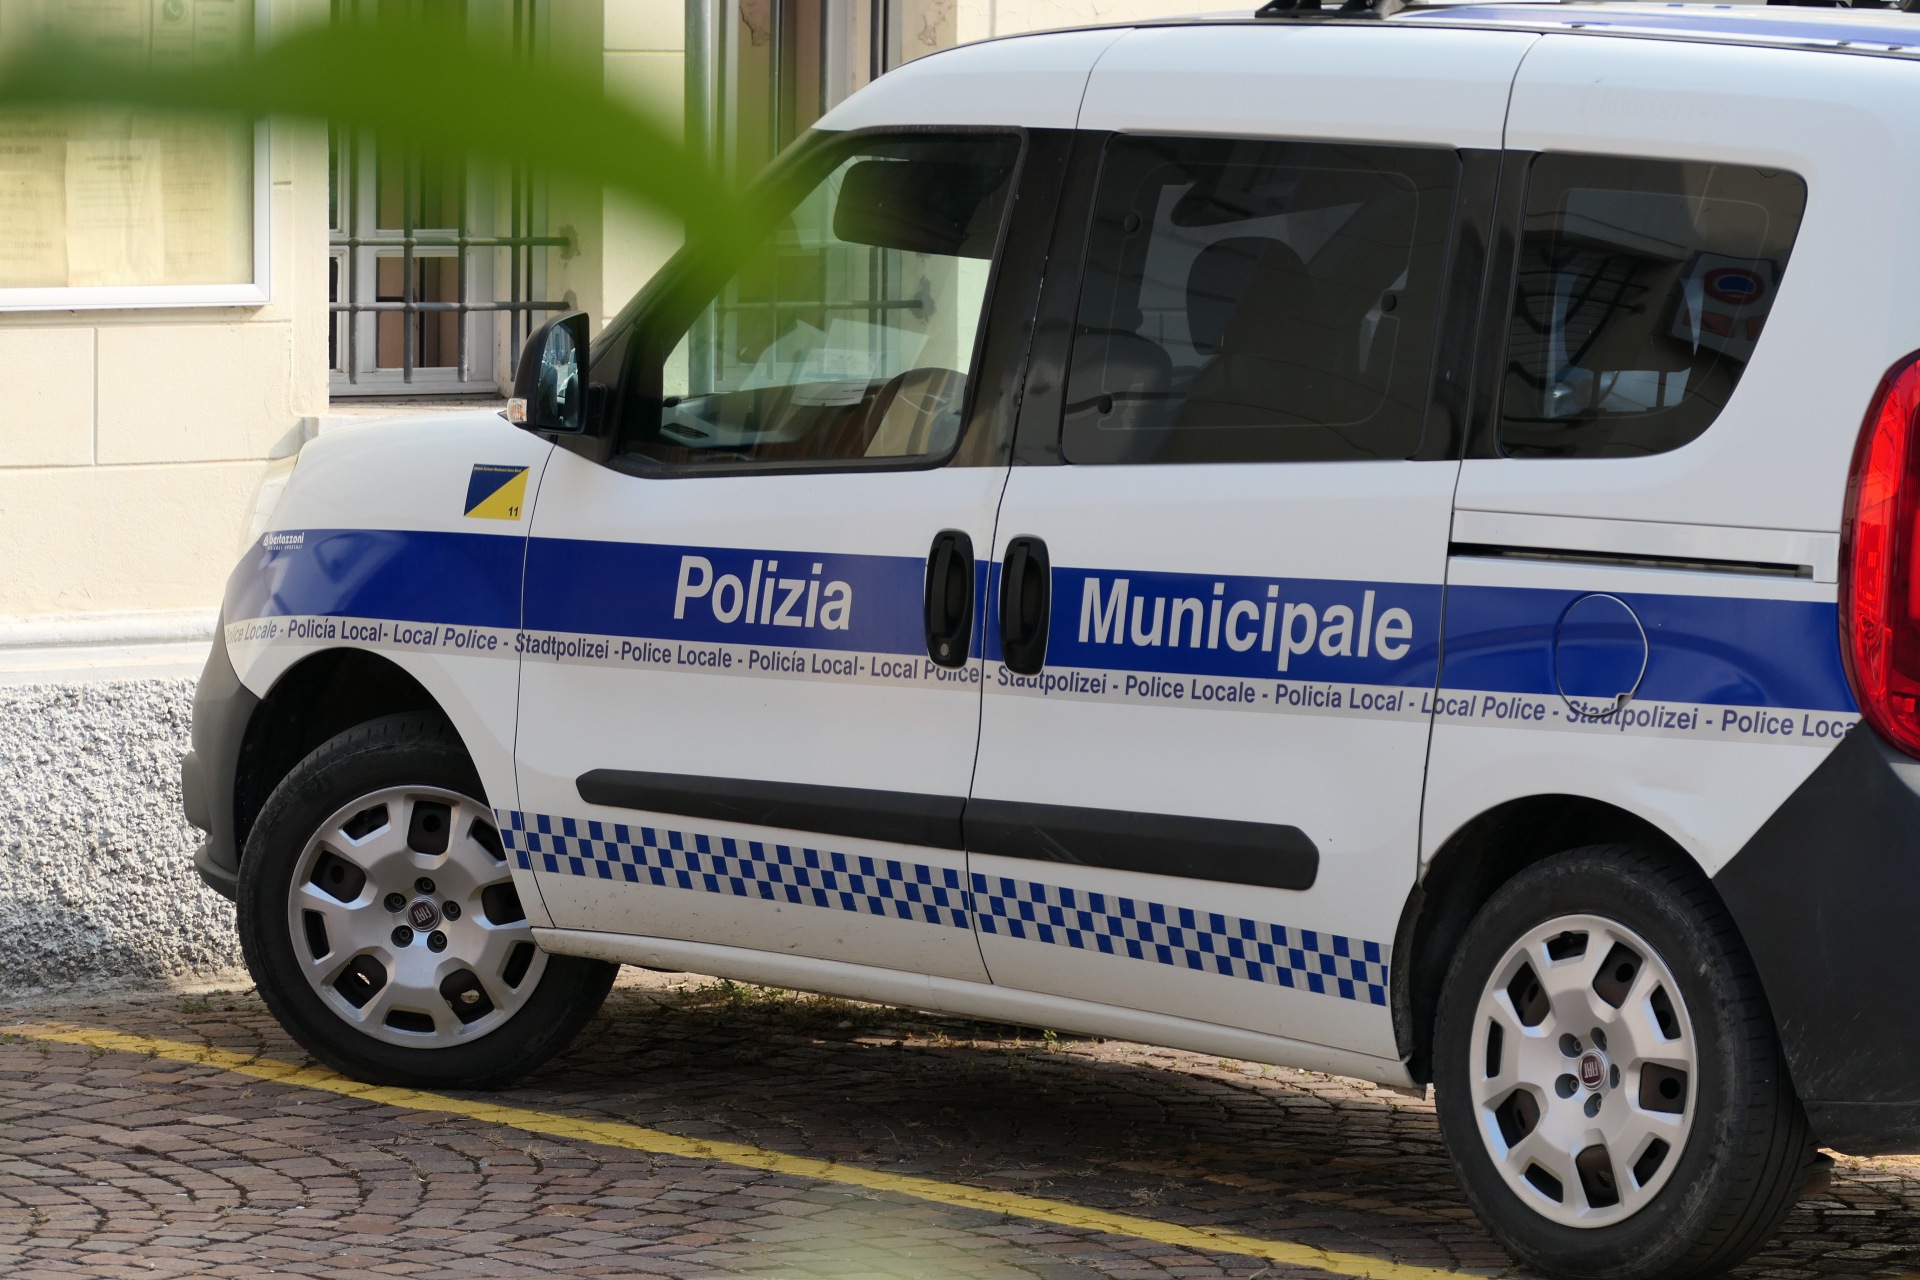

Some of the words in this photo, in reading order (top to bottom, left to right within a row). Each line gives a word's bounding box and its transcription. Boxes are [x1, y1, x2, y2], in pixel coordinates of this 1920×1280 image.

[508, 506, 519, 517] 11
[673, 555, 853, 631] Polizia
[1078, 577, 1414, 671] Municipale
[244, 619, 278, 641] Locale
[288, 617, 336, 640] Policía
[393, 624, 438, 646] Local
[443, 628, 498, 650] Police
[515, 633, 610, 661] Stadtpolizei
[677, 644, 733, 668] Locale
[749, 650, 806, 674] Policía
[870, 656, 919, 679] Local
[1125, 675, 1185, 699] Police
[1191, 679, 1256, 703] Locale
[1275, 683, 1343, 710] Policía
[1349, 687, 1405, 711] Local
[1421, 692, 1478, 717] Local
[1482, 696, 1546, 720] Police
[1566, 700, 1699, 731] Stadtpolizei
[1722, 709, 1794, 735] Police
[413, 905, 432, 923] FIAT
[1584, 1061, 1598, 1078] FIAT
